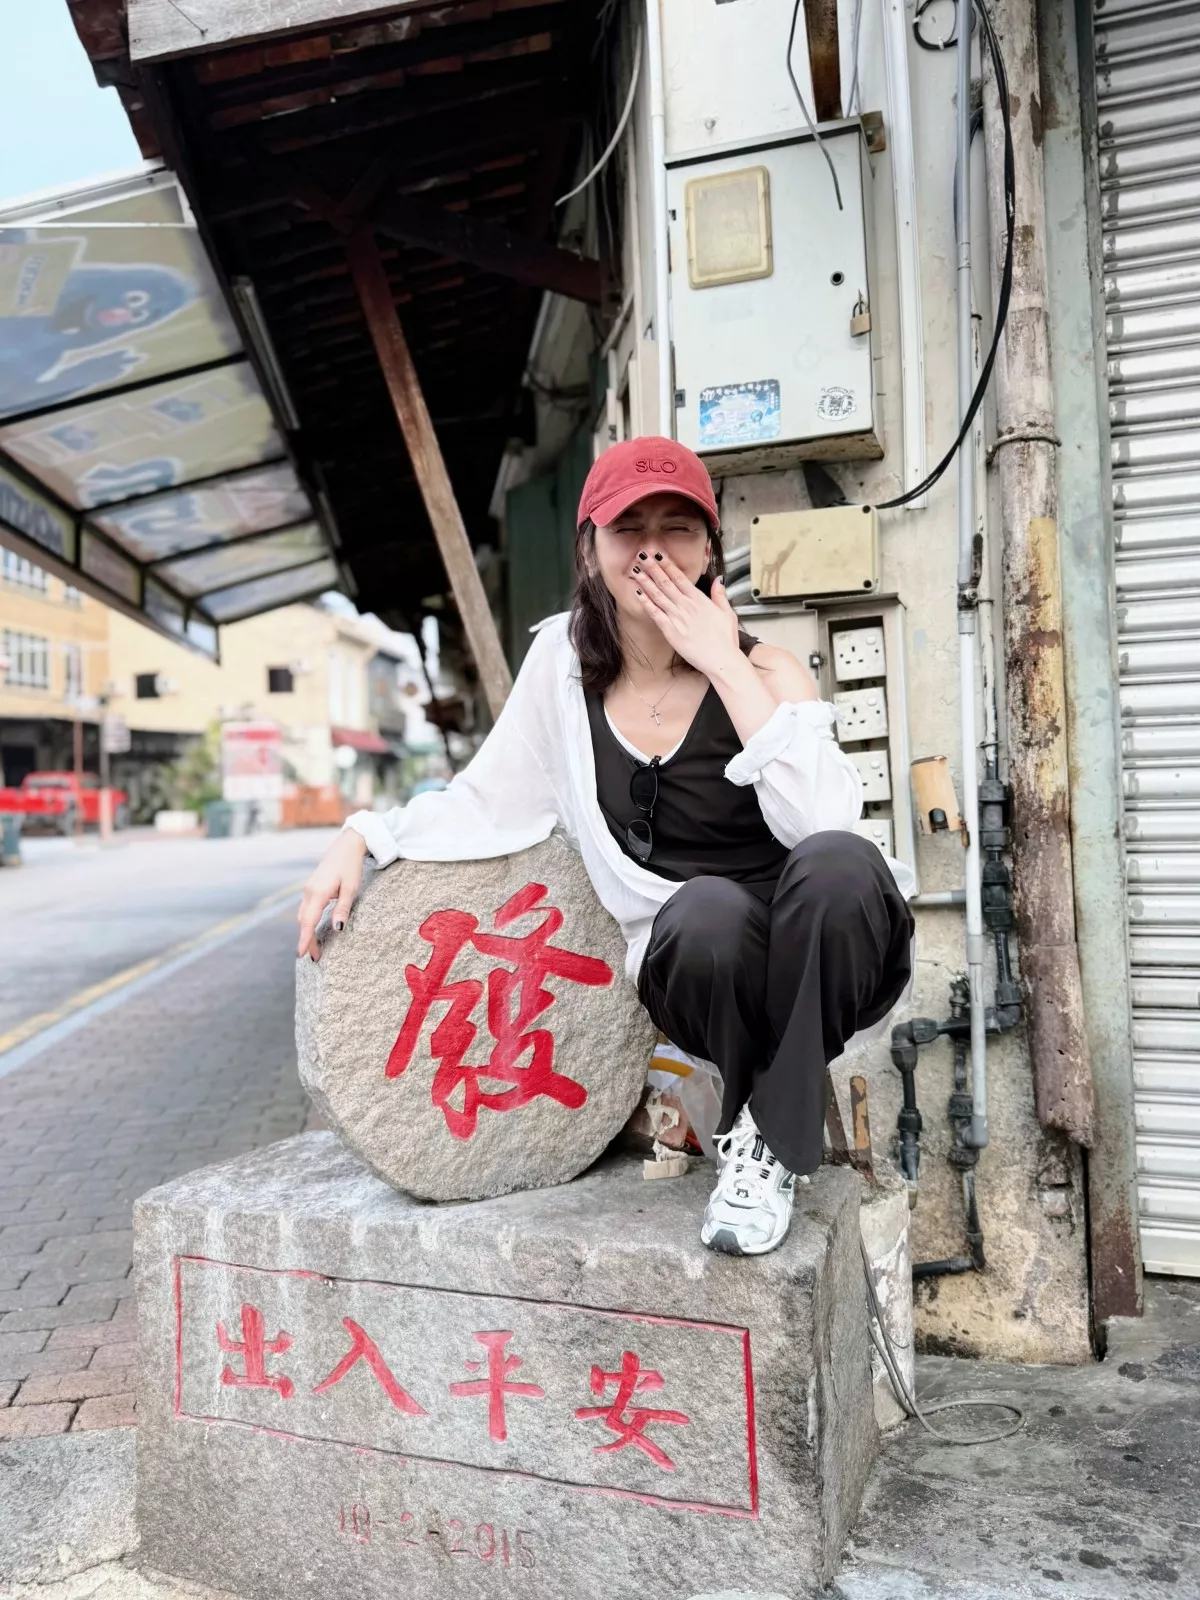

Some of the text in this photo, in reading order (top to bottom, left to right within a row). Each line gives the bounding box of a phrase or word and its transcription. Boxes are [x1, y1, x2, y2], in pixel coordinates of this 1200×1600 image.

[635, 458, 677, 474] SLO
[384, 881, 615, 1140] 發
[215, 1303, 691, 1471] 出入平安
